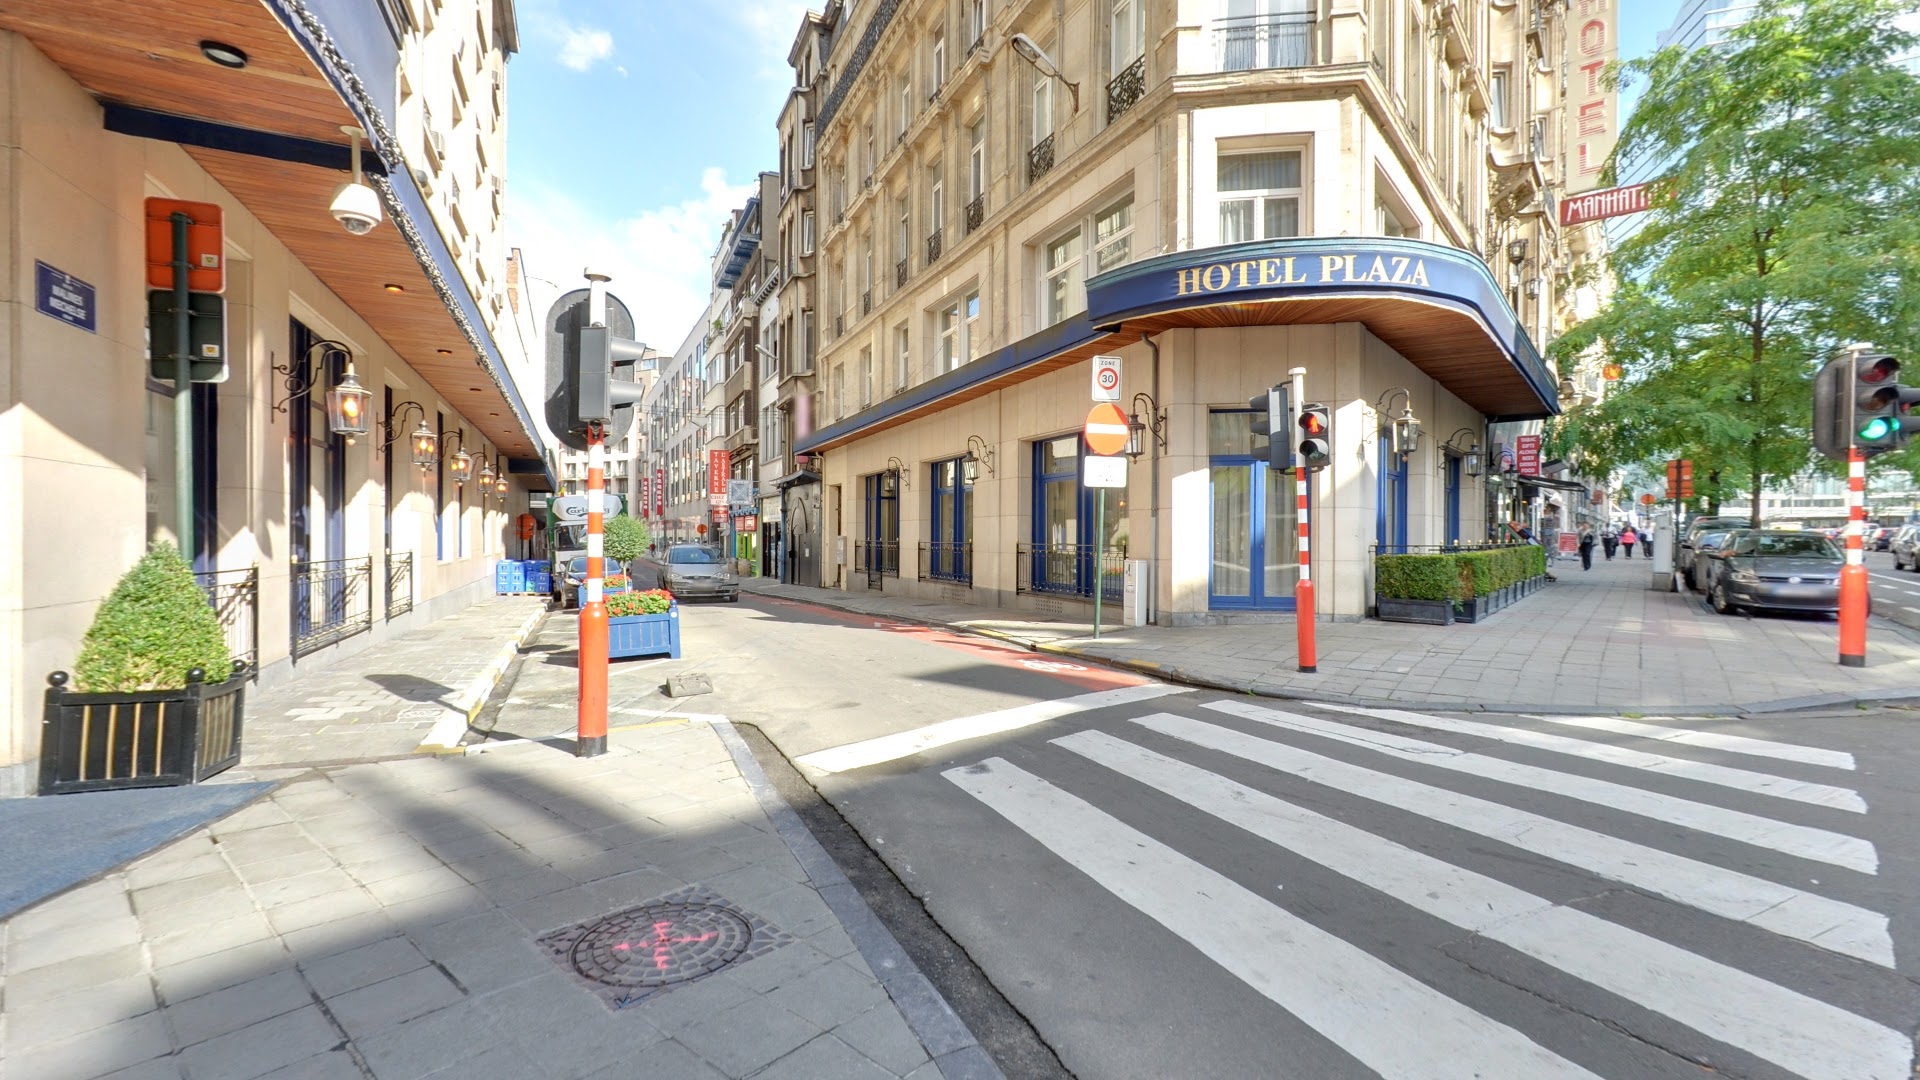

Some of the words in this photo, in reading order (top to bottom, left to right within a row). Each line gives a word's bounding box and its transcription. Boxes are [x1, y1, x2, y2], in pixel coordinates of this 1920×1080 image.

[1566, 182, 1670, 222] MANHATT
[1176, 257, 1307, 295] HOTEL
[1319, 255, 1430, 287] PLAZA
[1101, 374, 1114, 383] 30
[566, 507, 610, 516] Carlg
